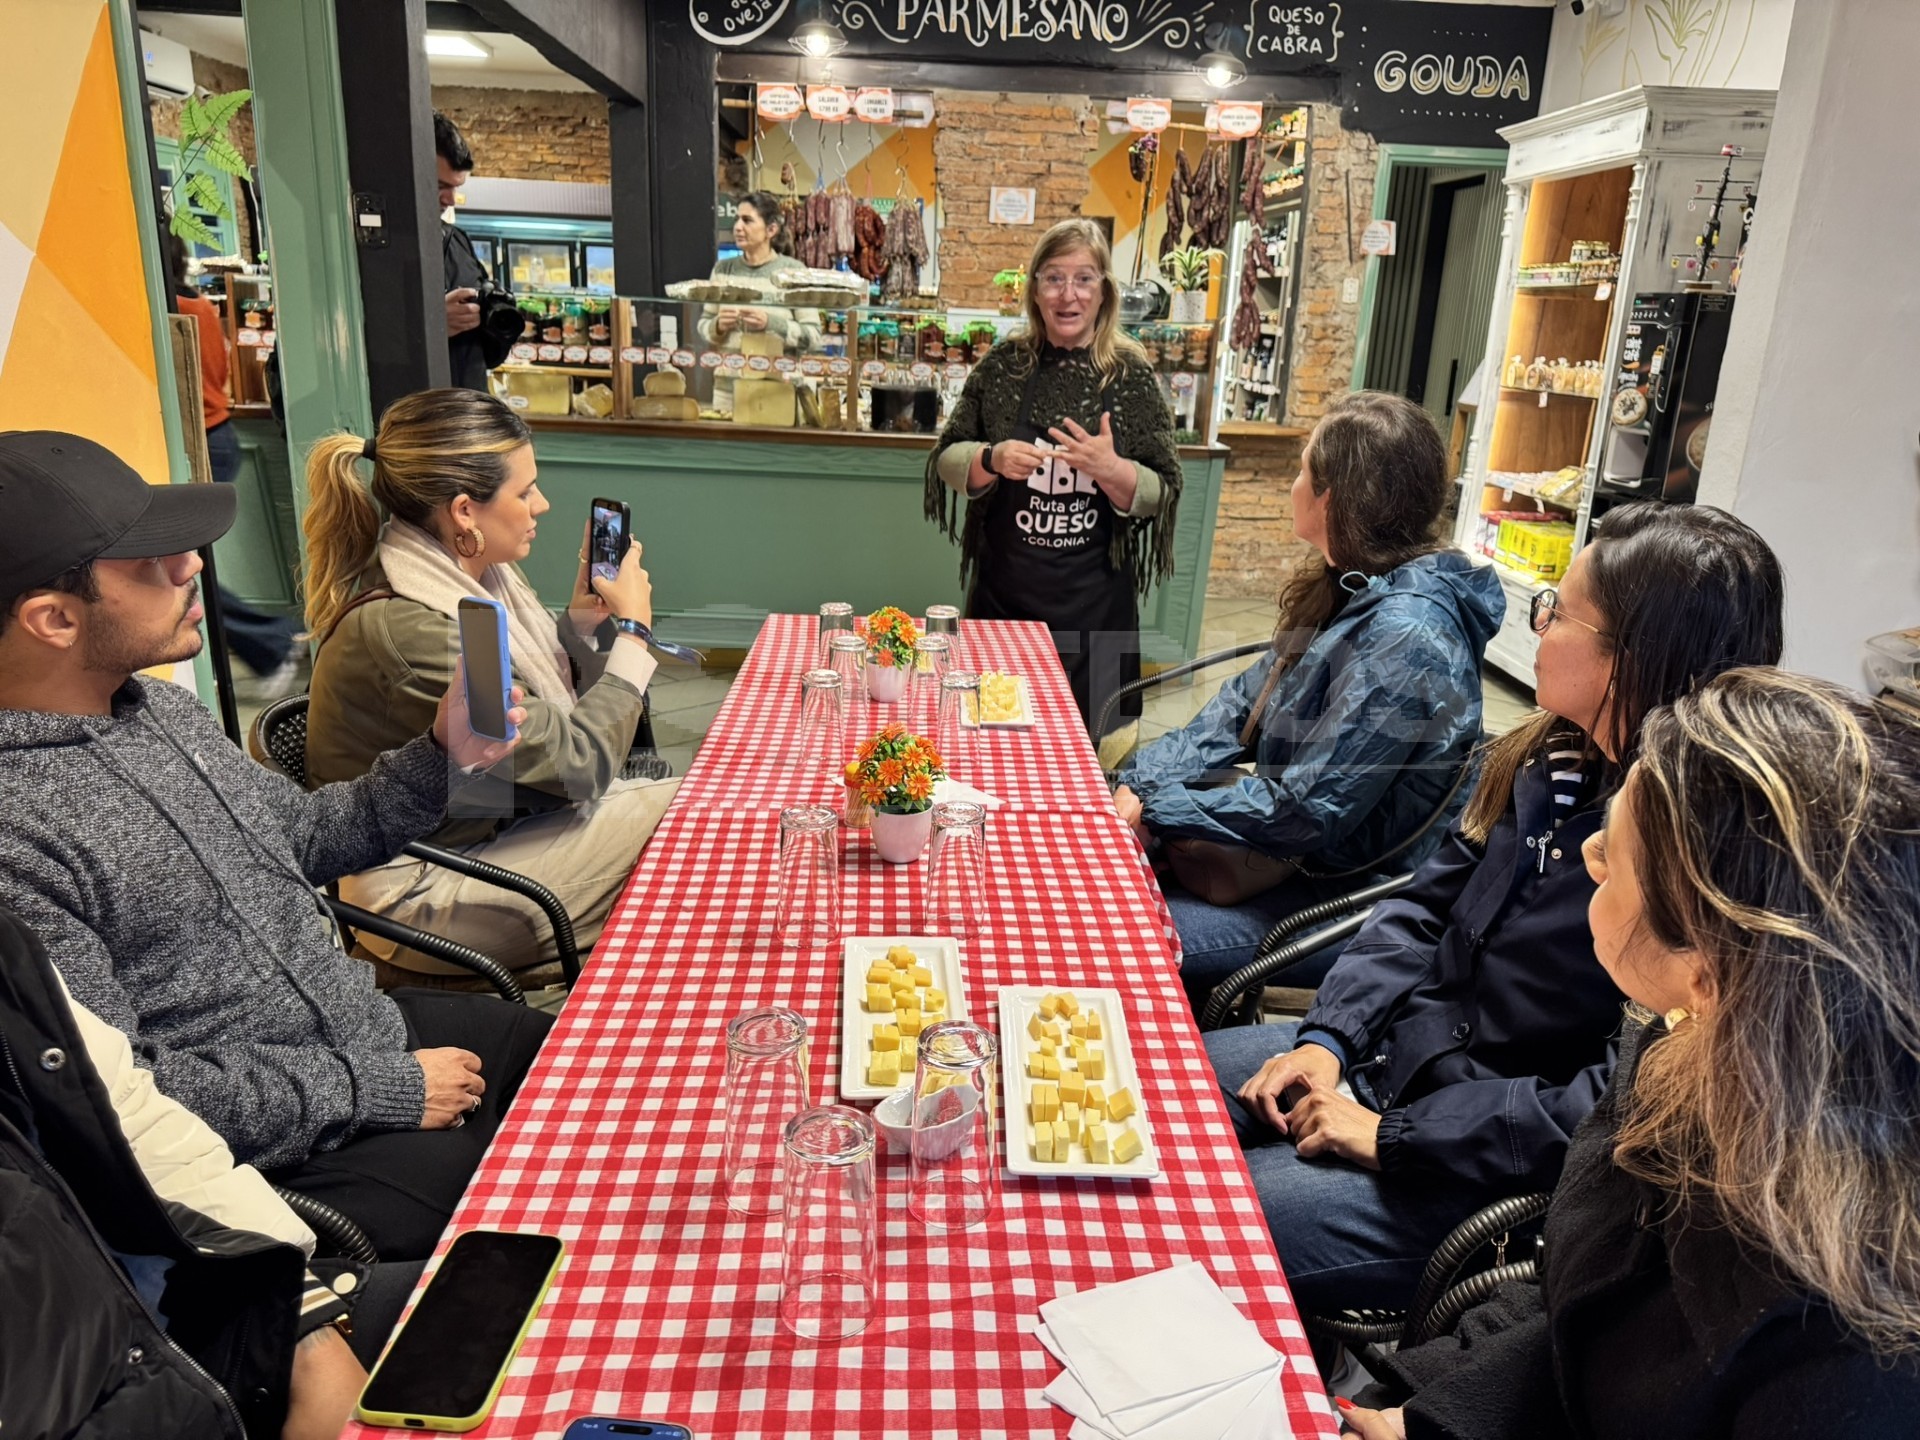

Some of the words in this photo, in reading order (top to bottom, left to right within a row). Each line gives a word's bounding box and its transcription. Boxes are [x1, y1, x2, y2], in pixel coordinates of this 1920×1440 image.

[1268, 5, 1325, 26] QUESO
[1286, 23, 1301, 36] DE
[1257, 34, 1323, 55] CABRA
[1374, 50, 1530, 101] GOUDA
[1029, 495, 1066, 513] Ruta
[1069, 496, 1090, 513] del
[1015, 508, 1099, 534] QUESO
